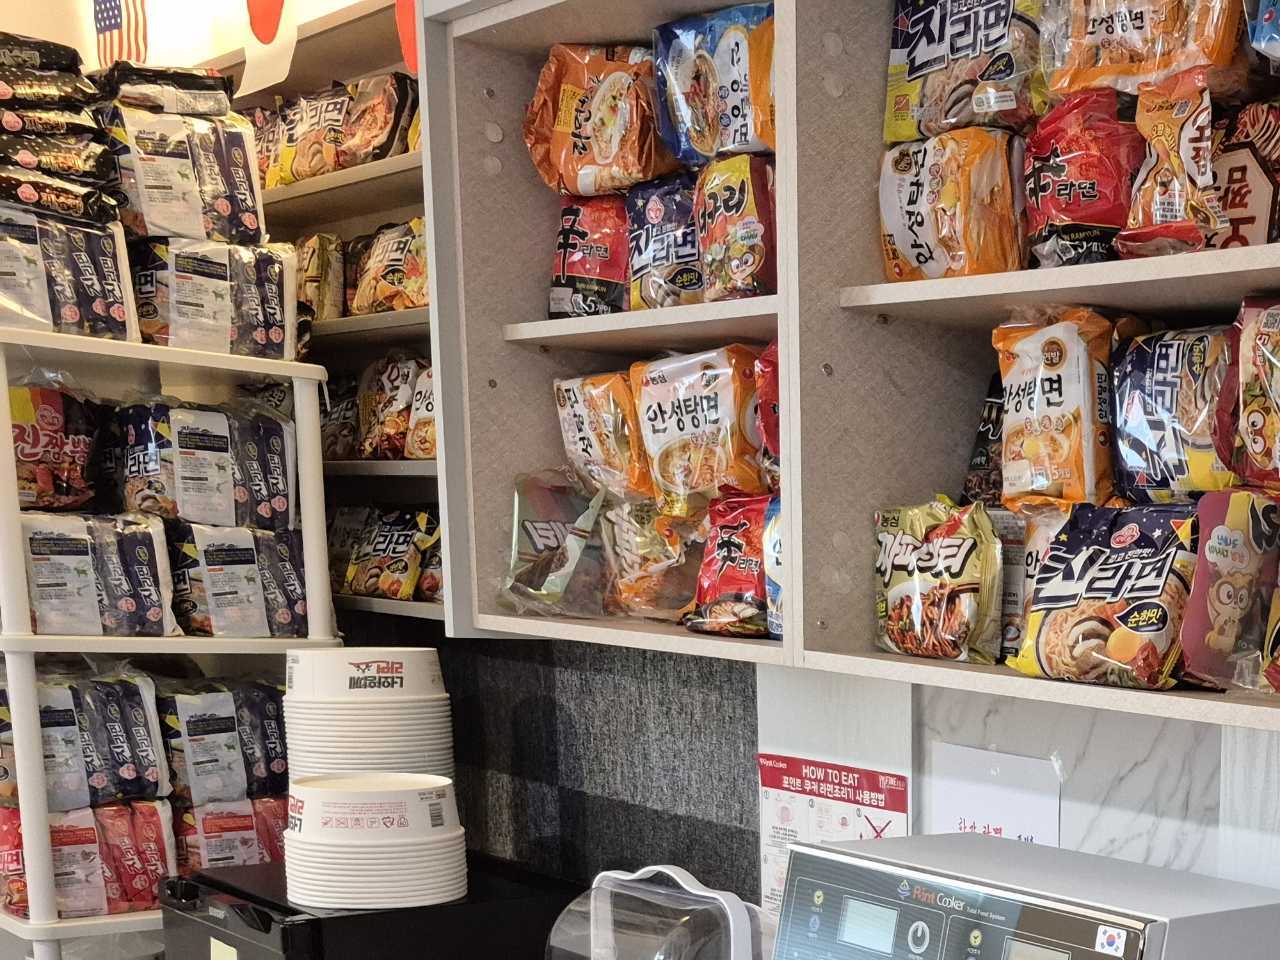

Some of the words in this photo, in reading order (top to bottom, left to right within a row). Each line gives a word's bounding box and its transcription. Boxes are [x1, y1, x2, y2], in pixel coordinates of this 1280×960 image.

[907, 0, 1014, 82] 진라면
[1055, 180, 1099, 203] 라면
[579, 243, 610, 259] 라면
[629, 224, 700, 283] 진라면
[646, 391, 721, 434] 안성탕면
[881, 514, 900, 528] 농심
[876, 529, 978, 589] 짜파게티
[1031, 545, 1177, 612] 진라면
[1127, 608, 1162, 628] 순한맛
[801, 764, 825, 781] HOW
[826, 768, 840, 784] TO
[841, 770, 860, 787] EAT
[855, 788, 885, 807] 사용방법
